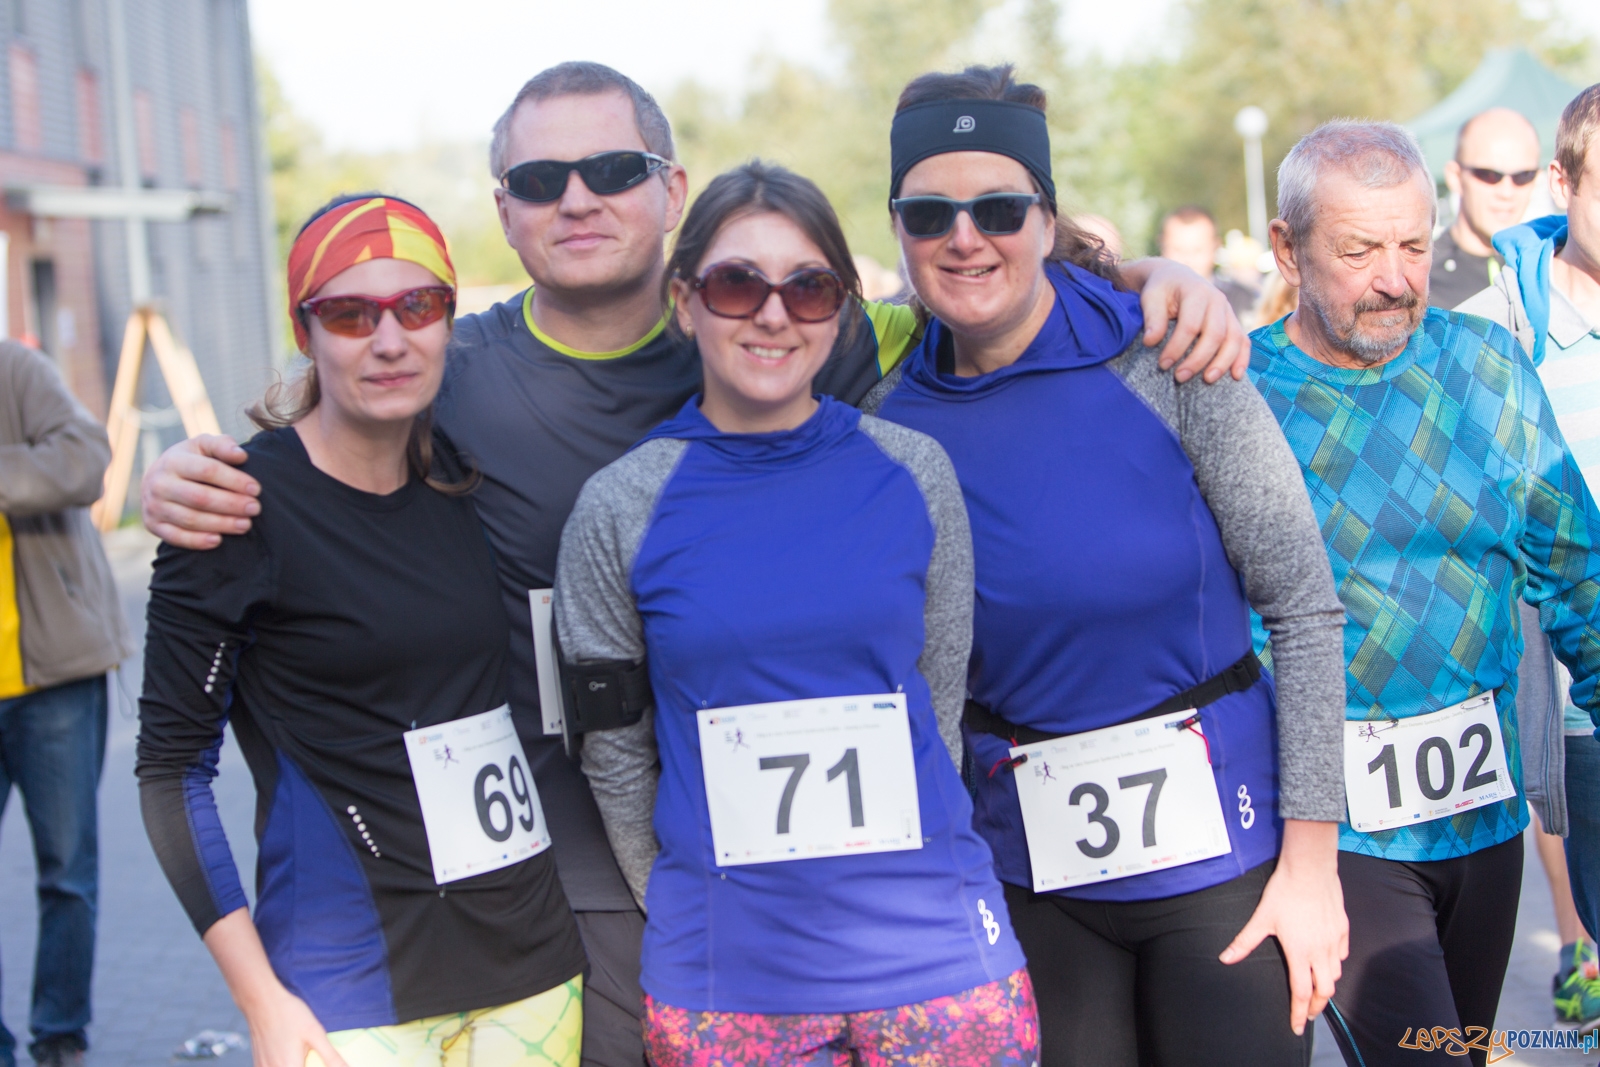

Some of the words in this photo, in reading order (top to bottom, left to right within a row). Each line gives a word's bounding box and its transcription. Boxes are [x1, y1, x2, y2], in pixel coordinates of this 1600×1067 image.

[474, 754, 535, 843] 69
[758, 748, 865, 835] 71
[1367, 722, 1498, 809] 102
[1068, 767, 1168, 859] 37
